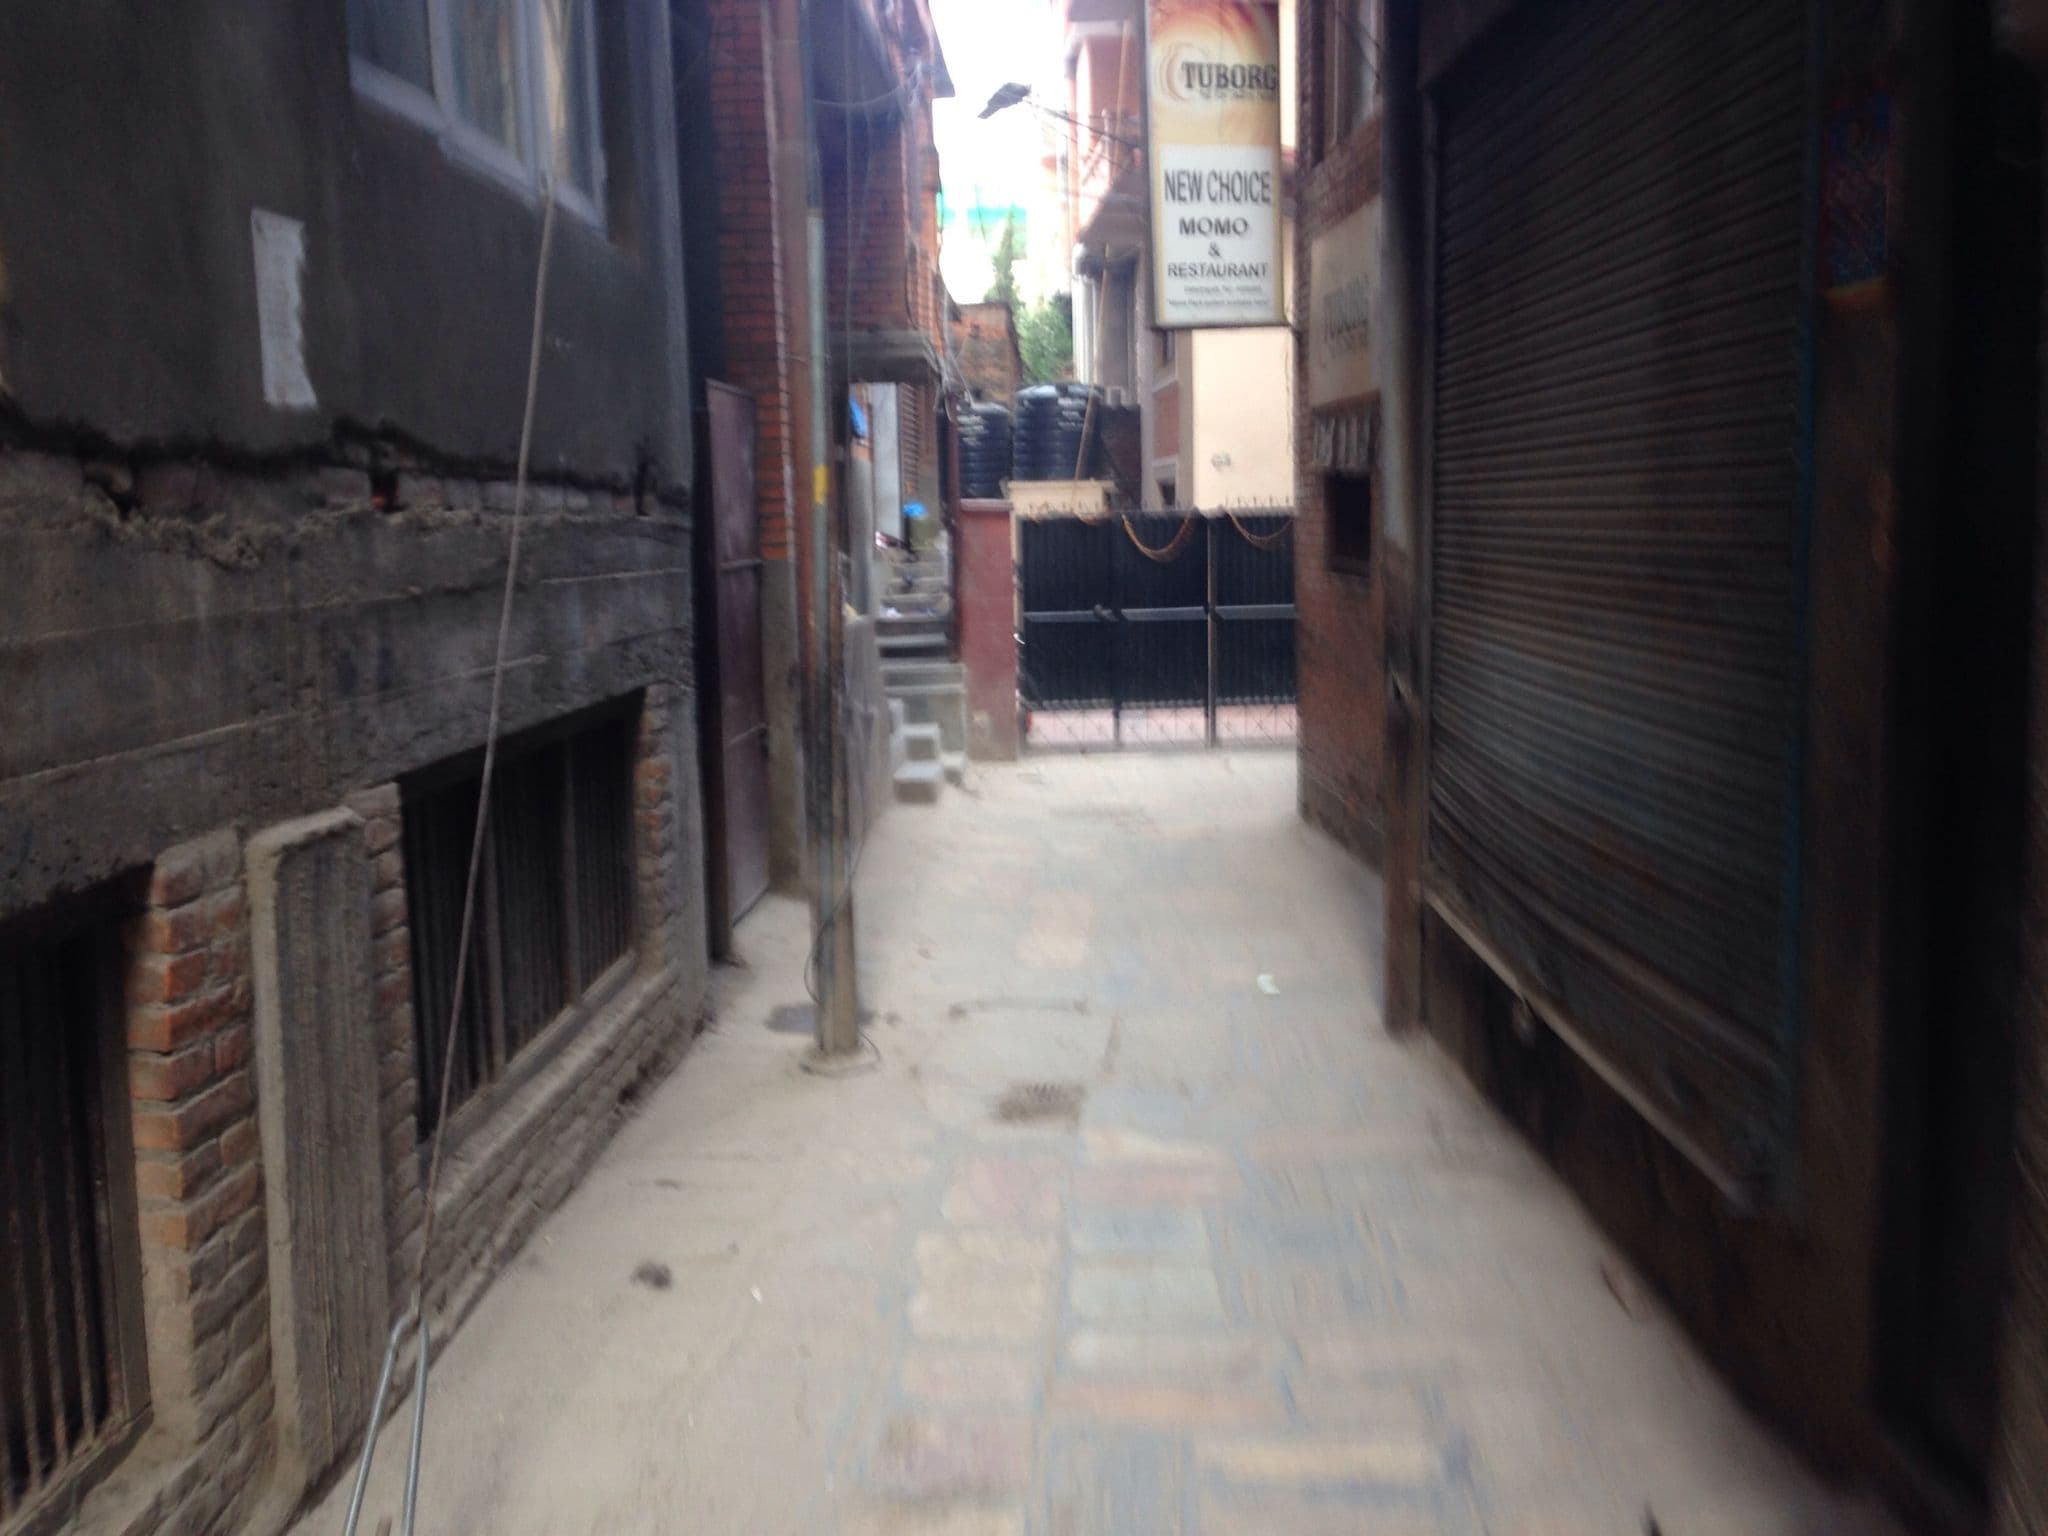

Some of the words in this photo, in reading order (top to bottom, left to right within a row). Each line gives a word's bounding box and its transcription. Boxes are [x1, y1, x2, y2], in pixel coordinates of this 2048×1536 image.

[1181, 61, 1279, 90] TUBORG
[1164, 169, 1202, 201] NEW
[1207, 169, 1271, 203] CHOICE
[1179, 216, 1248, 236] MOMO
[1208, 241, 1220, 257] &
[1167, 262, 1268, 278] RESTAURANT
